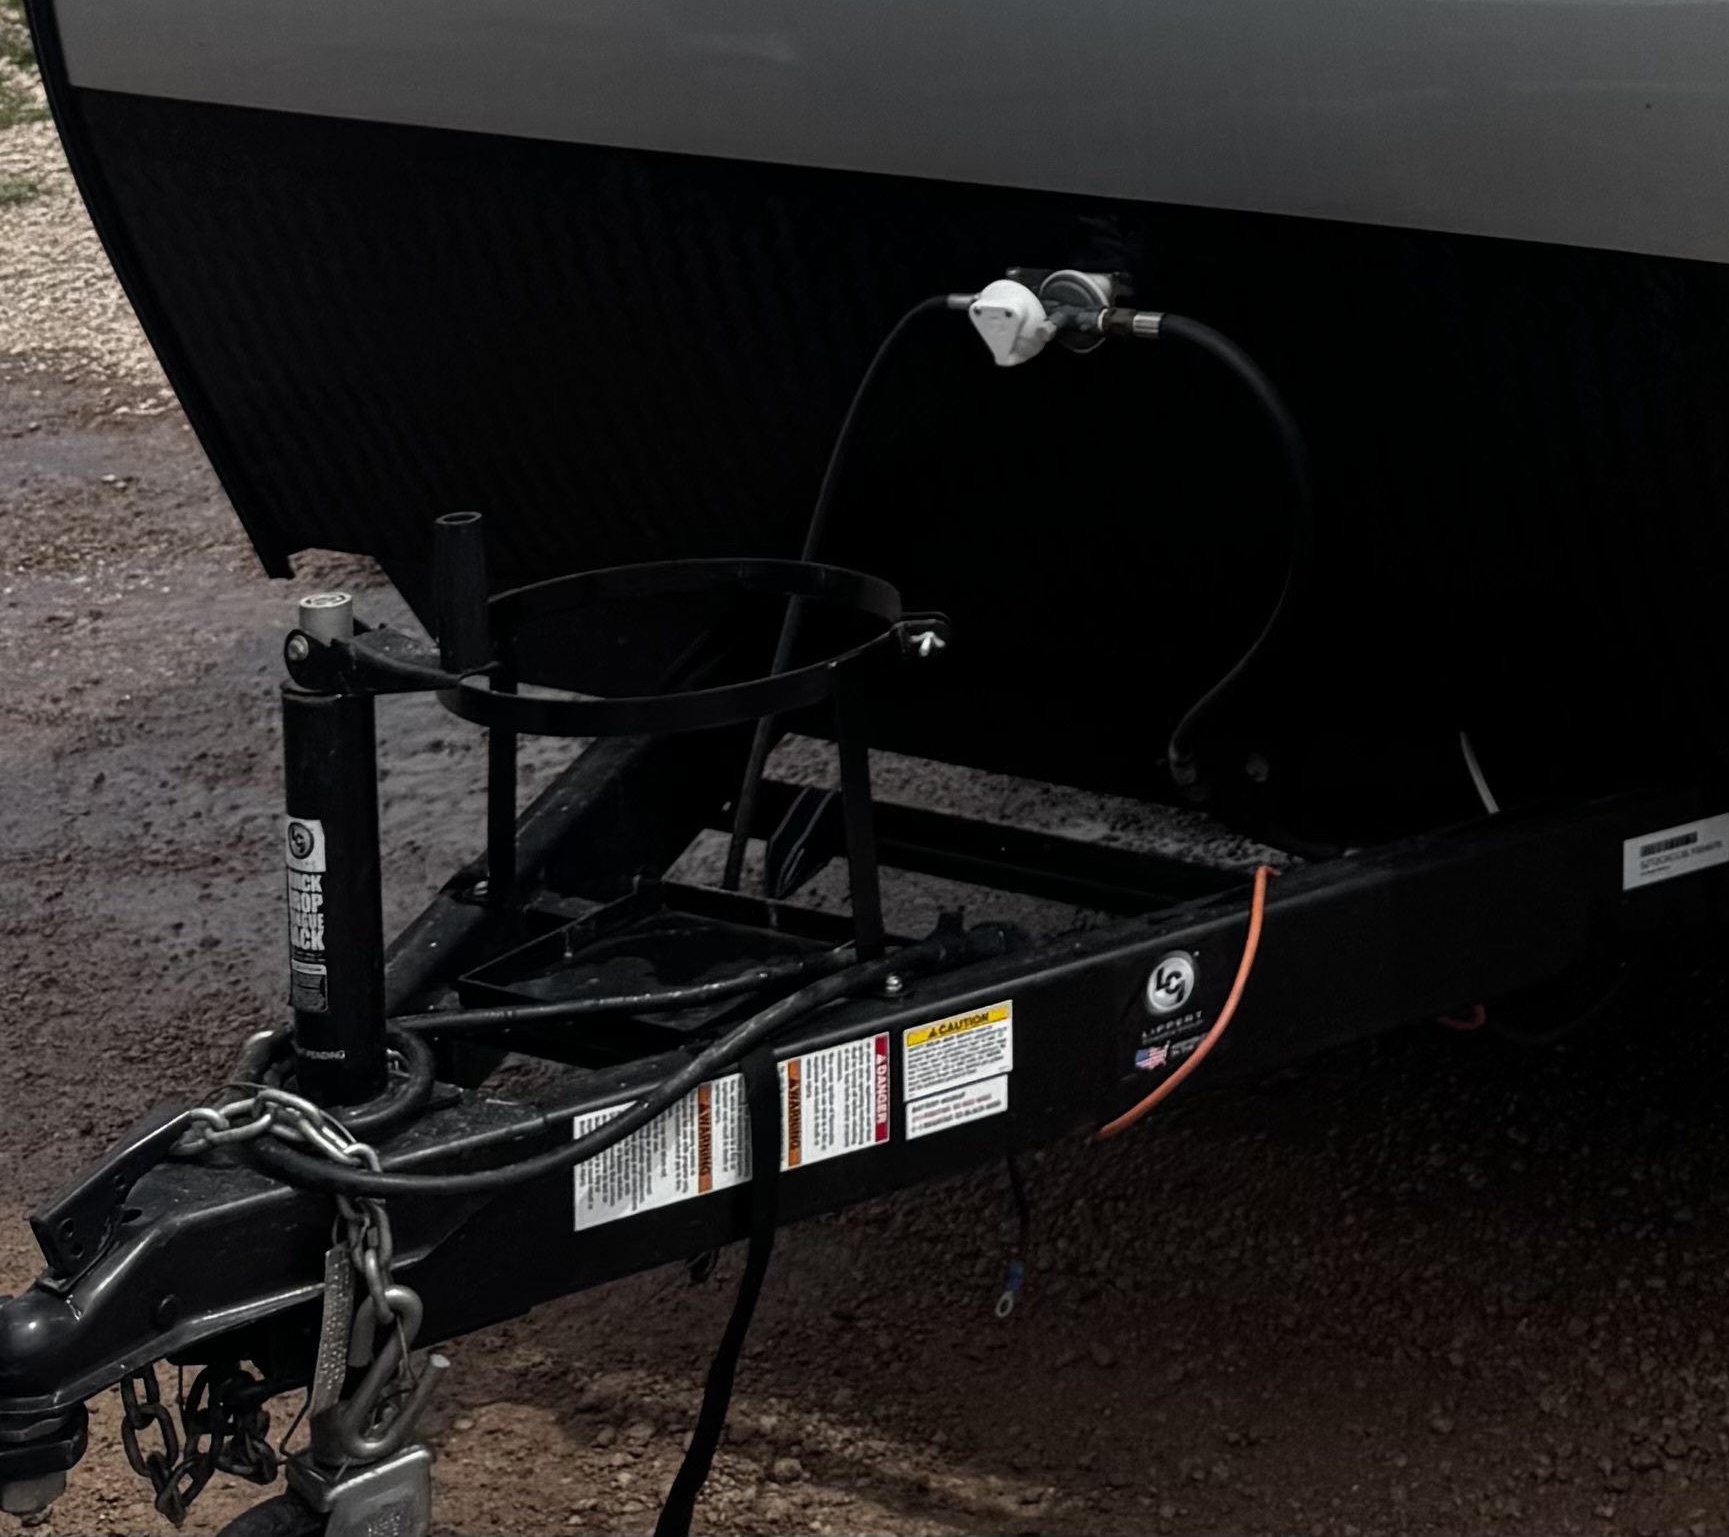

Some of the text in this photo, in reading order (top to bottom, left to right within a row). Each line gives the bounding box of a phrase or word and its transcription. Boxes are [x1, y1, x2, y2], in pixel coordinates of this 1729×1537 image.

[937, 1012, 990, 1035] CAUTION
[789, 1086, 801, 1149] WARNING
[876, 1065, 888, 1124] DANGER
[698, 1114, 711, 1176] WARNING
